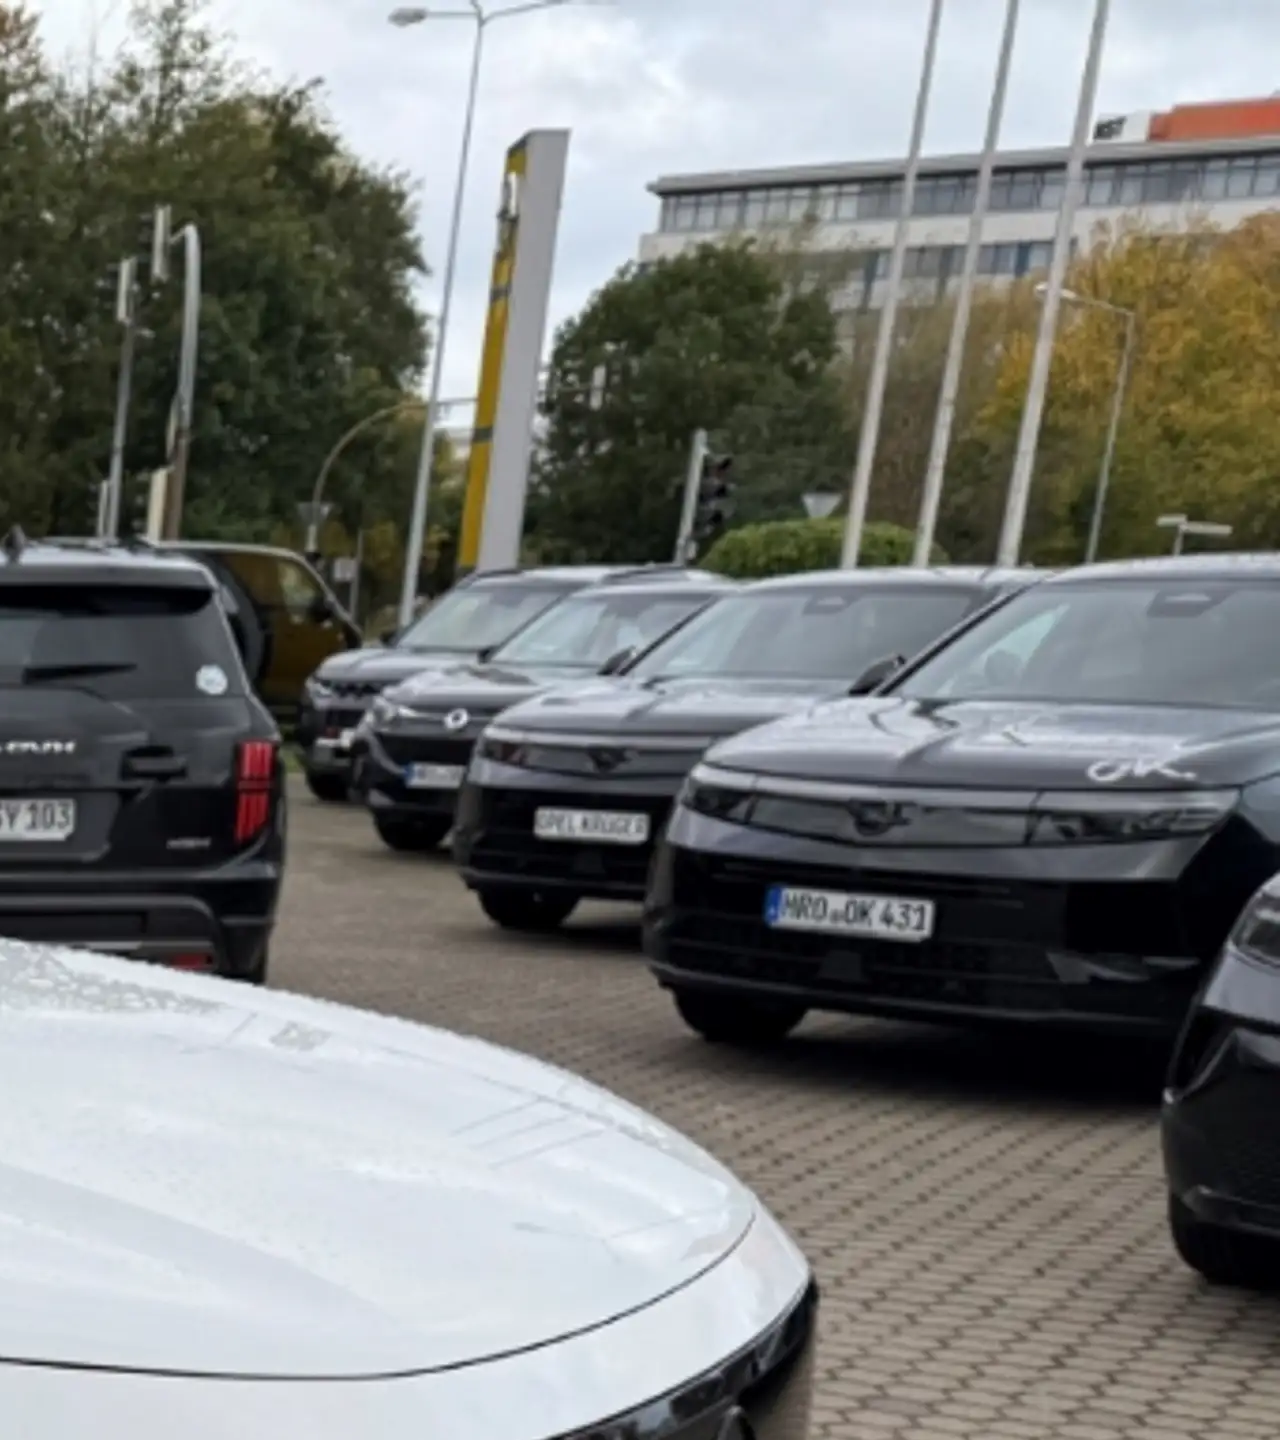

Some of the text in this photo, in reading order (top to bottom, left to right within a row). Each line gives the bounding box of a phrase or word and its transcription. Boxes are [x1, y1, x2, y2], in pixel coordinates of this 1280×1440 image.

[26, 803, 71, 831] 103
[783, 891, 927, 932] HRO OK 431
